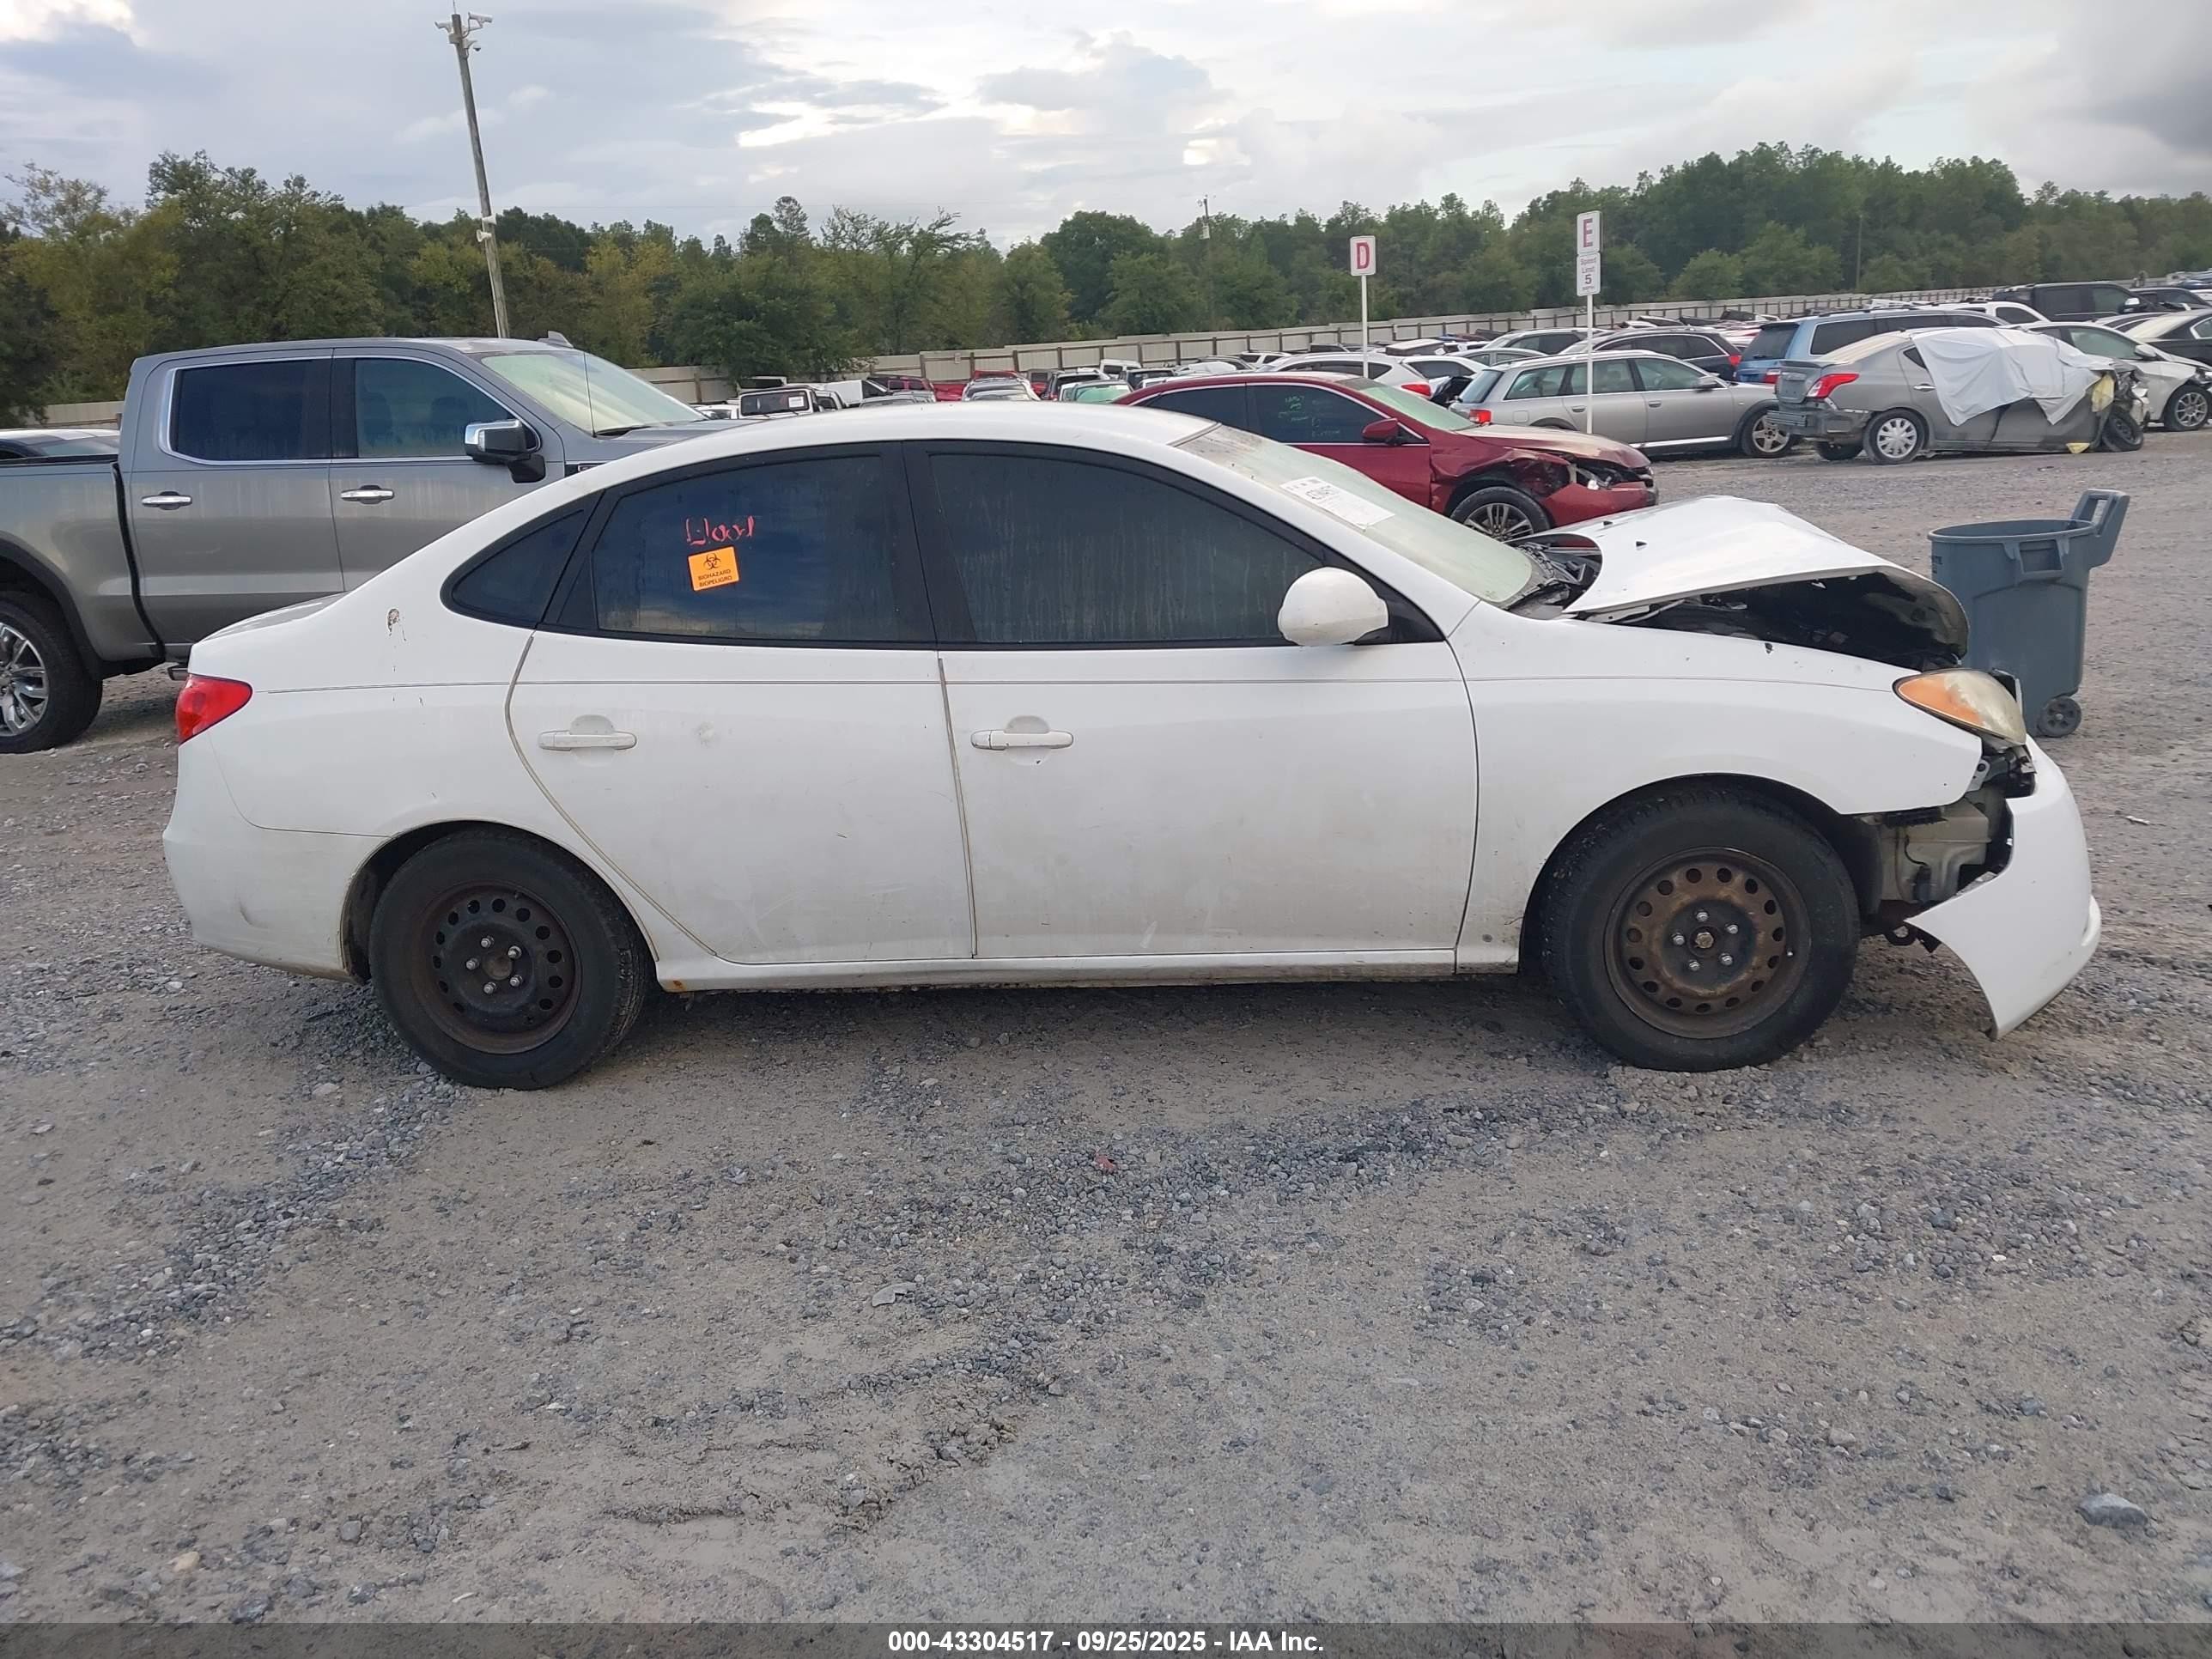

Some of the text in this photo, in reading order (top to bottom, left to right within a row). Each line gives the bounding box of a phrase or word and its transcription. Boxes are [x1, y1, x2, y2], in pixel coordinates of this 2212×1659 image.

[1583, 218, 1593, 248] E
[1356, 241, 1370, 270] D
[1584, 274, 1592, 284] 5
[698, 568, 732, 580] BIOHAZARD
[699, 575, 732, 587] BIOPELIGRO
